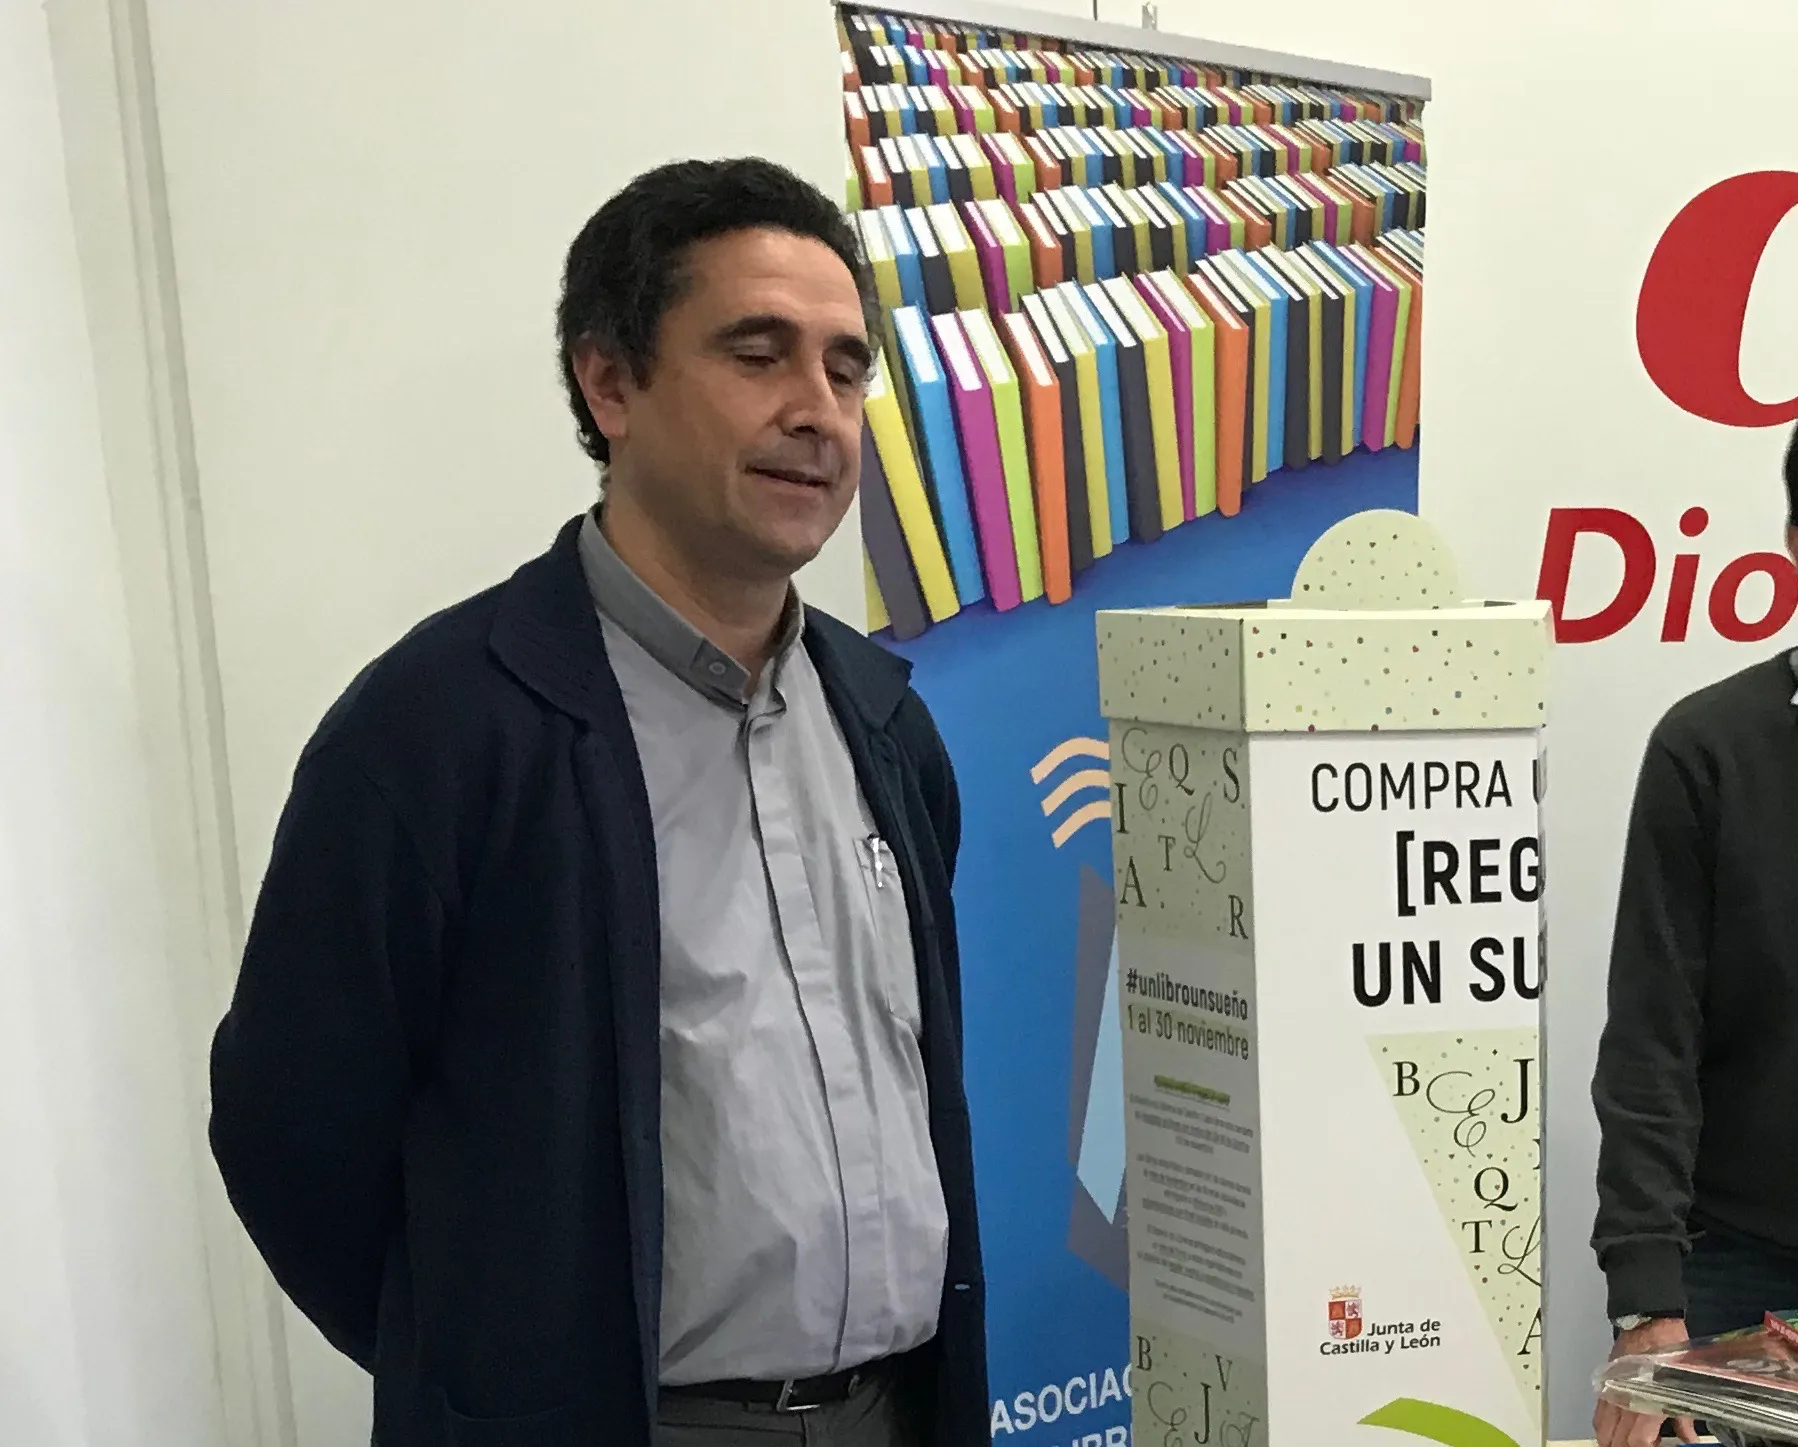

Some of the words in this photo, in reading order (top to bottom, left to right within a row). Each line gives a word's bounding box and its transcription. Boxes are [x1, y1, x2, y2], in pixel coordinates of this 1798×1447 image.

[1168, 742, 1194, 796] Q
[1222, 747, 1241, 804] S
[1311, 759, 1512, 813] COMPRA
[1157, 834, 1176, 872] T
[1396, 830, 1546, 917] [REG
[1119, 856, 1148, 909] A
[1228, 893, 1248, 940] R
[1126, 968, 1249, 1022] #unlibrounsueño
[1352, 940, 1442, 1008] UN
[1468, 936, 1547, 1001] SU
[1127, 1004, 1135, 1033] 1
[1138, 1008, 1152, 1038] al
[1155, 1012, 1173, 1042] 30
[1175, 1014, 1249, 1061] noviembre
[1393, 1061, 1421, 1098] B
[1500, 1058, 1535, 1125] J
[1473, 1166, 1519, 1212] Q
[1461, 1219, 1493, 1255] T
[1319, 1337, 1380, 1357] Castilla
[1384, 1339, 1395, 1354] y
[1400, 1332, 1441, 1351] León
[1367, 1322, 1415, 1339] Junta
[1420, 1318, 1441, 1333] de
